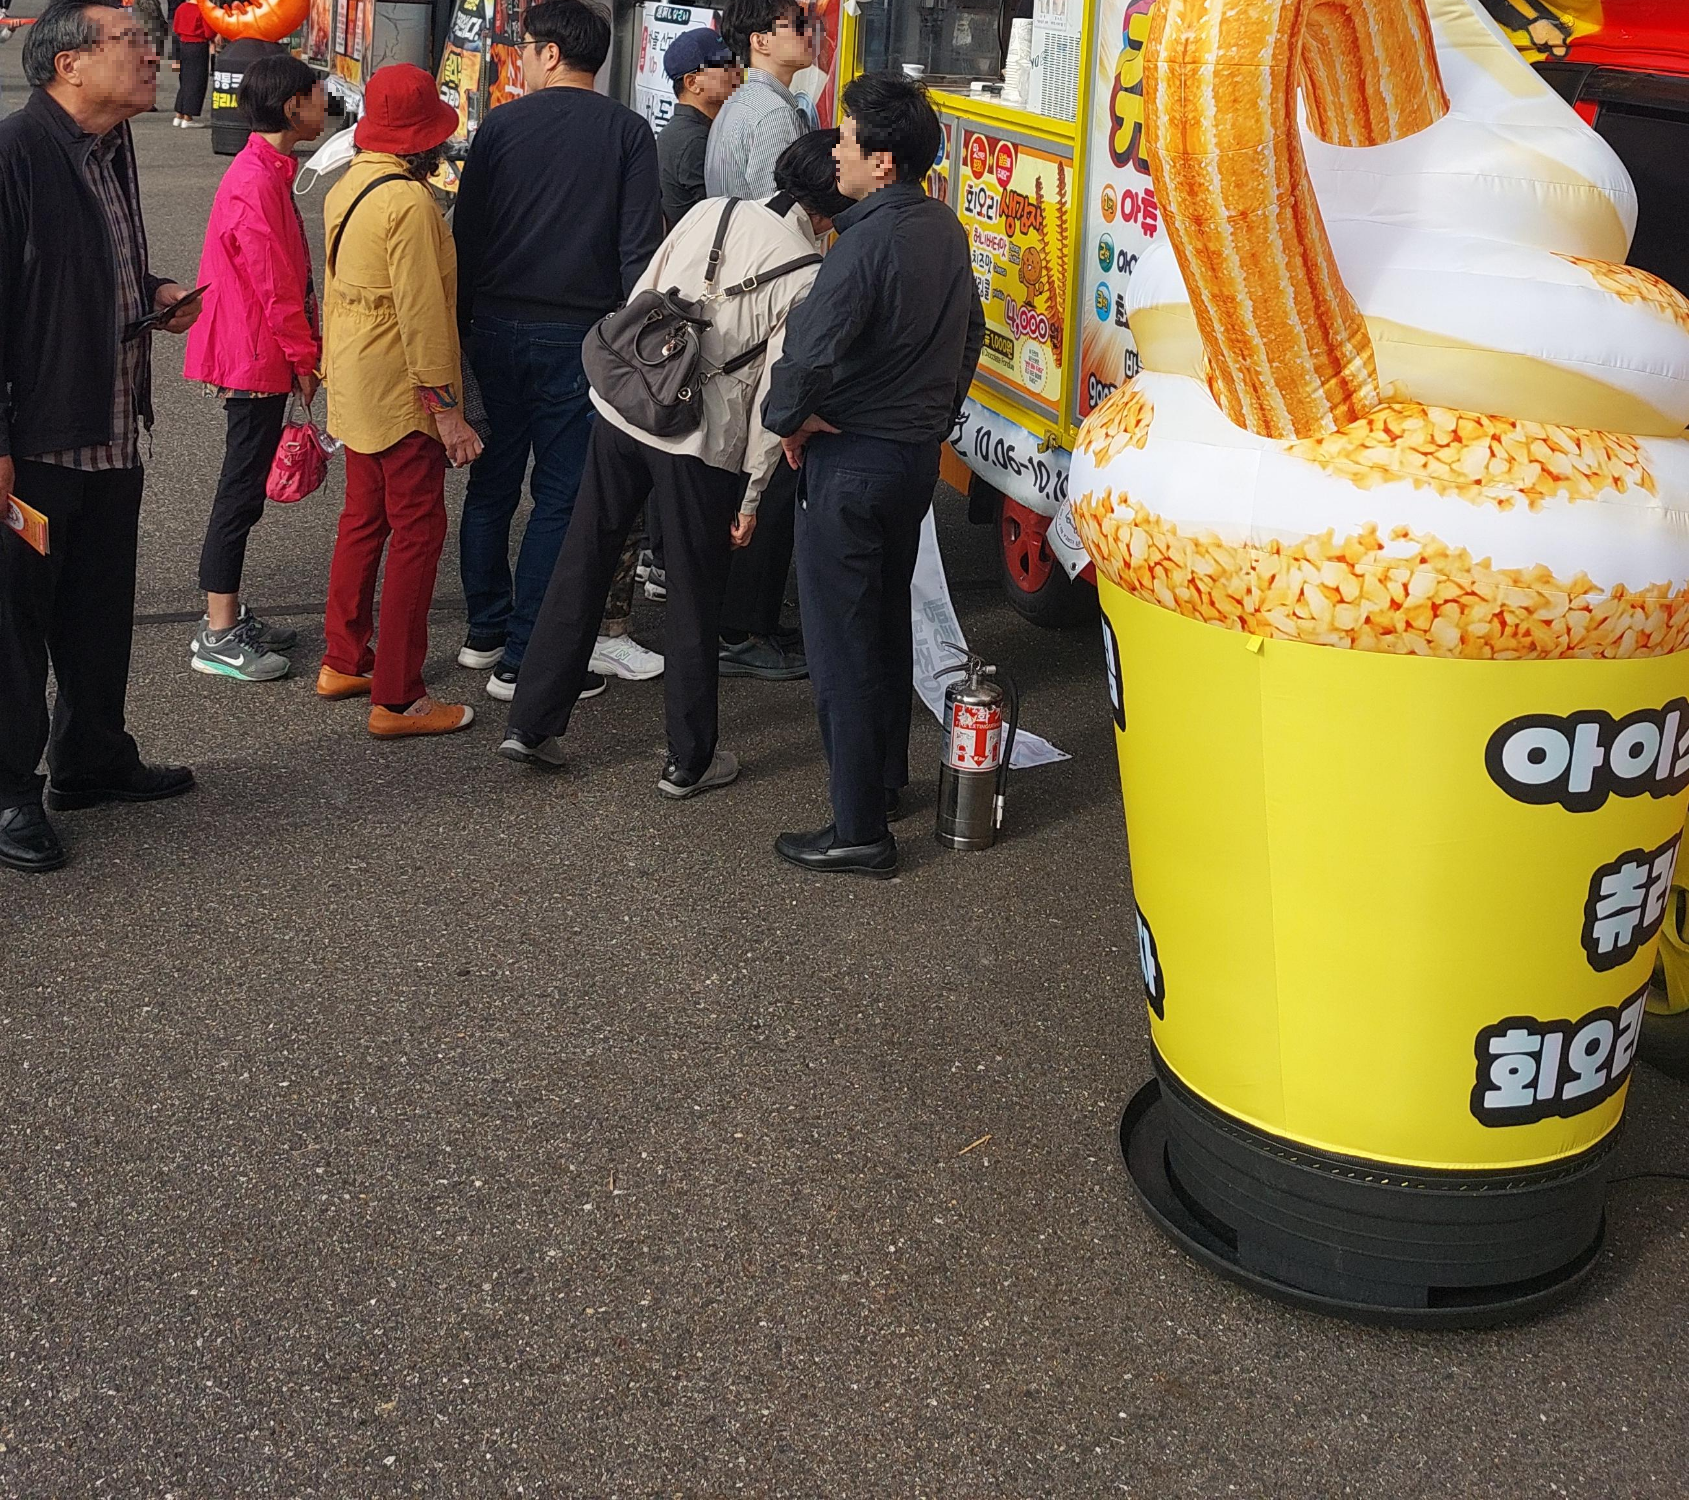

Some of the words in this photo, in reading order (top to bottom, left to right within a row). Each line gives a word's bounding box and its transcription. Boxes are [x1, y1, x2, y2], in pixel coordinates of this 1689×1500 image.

[964, 183, 999, 222] 회오리
[999, 188, 1043, 238] 생감자
[973, 226, 1007, 258] 허니버터맛
[971, 249, 993, 275] 치즈맛
[975, 274, 991, 301] 링클
